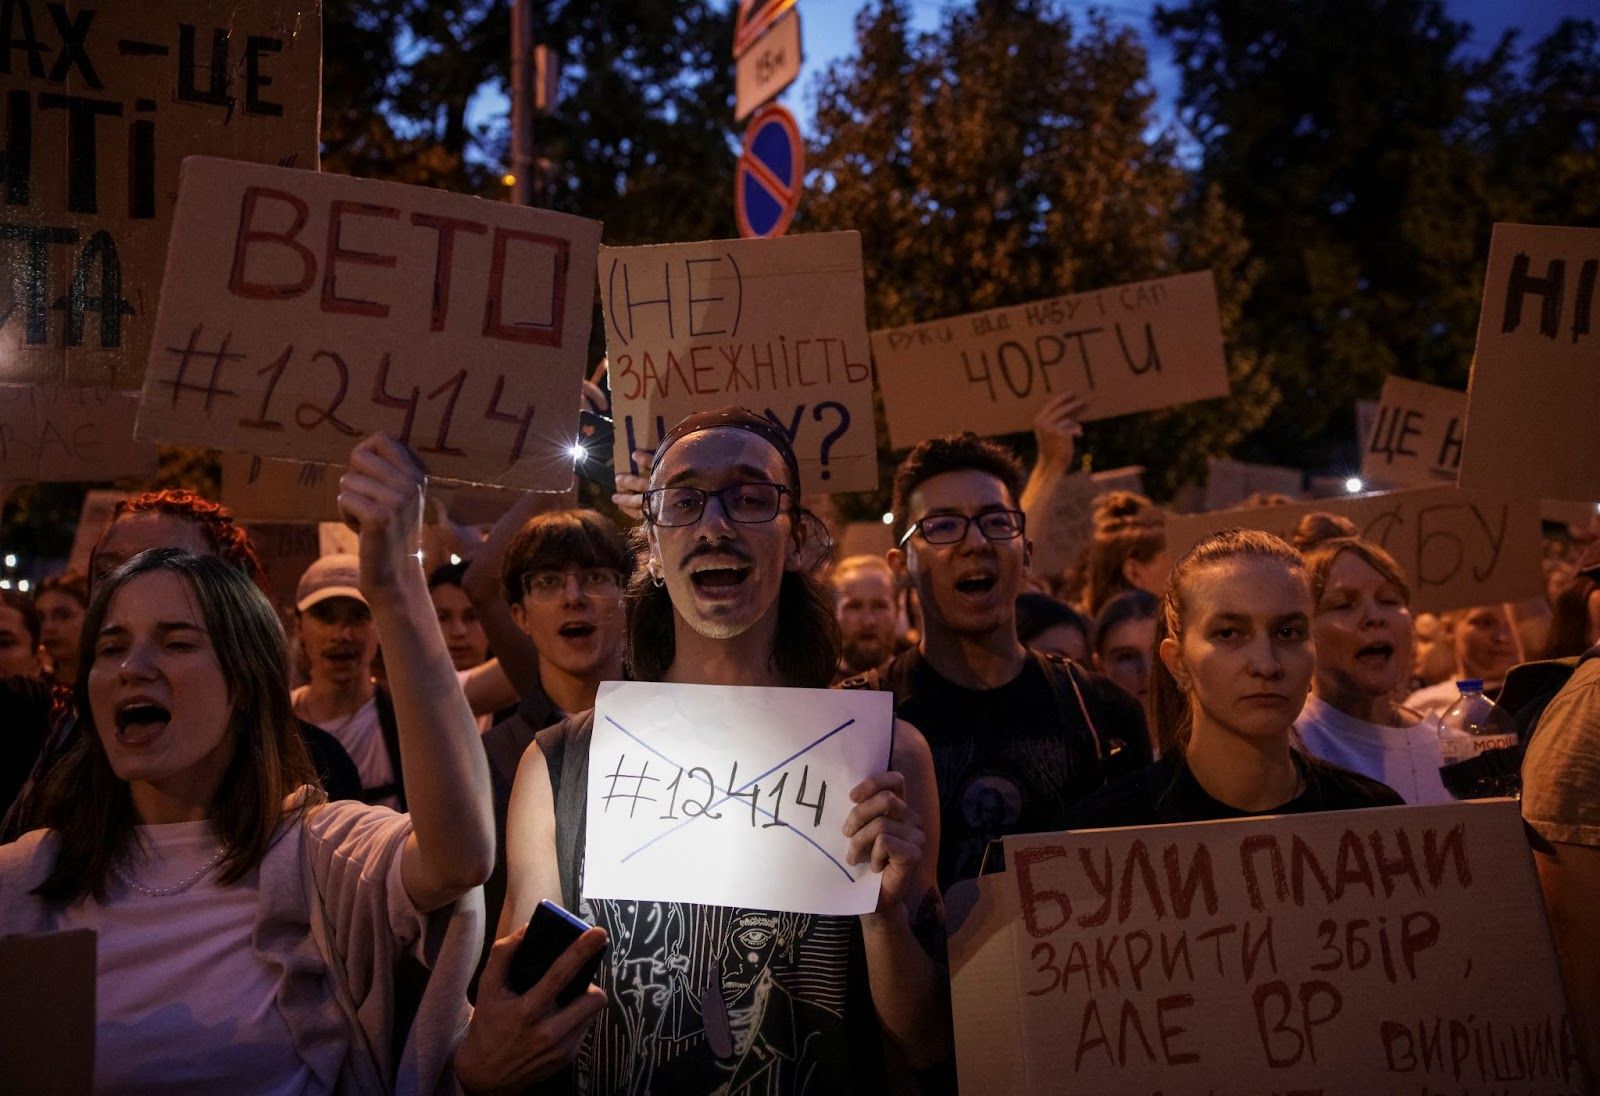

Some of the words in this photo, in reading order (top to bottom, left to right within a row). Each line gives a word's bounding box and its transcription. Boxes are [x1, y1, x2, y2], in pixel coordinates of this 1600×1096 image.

[227, 186, 571, 348] ВЕТО
[609, 252, 742, 345] (НЕ)
[971, 313, 1010, 335] ВІД
[1025, 299, 1081, 326] НАБУ
[1118, 284, 1169, 311] САП
[160, 322, 535, 466] #12414
[616, 333, 870, 400] ЗАЛЕЖНІСТЬ
[961, 322, 1162, 402] ЧОРТИ
[1370, 407, 1424, 464] ЦЕ
[602, 754, 827, 829] #12414
[1014, 838, 1220, 939] БУЛИ
[1239, 822, 1475, 908] ПЛАНИ
[1028, 916, 1279, 997] ЗАКРИТИ
[1074, 993, 1201, 1072] АЛЕ
[1252, 980, 1344, 1069] ВР
